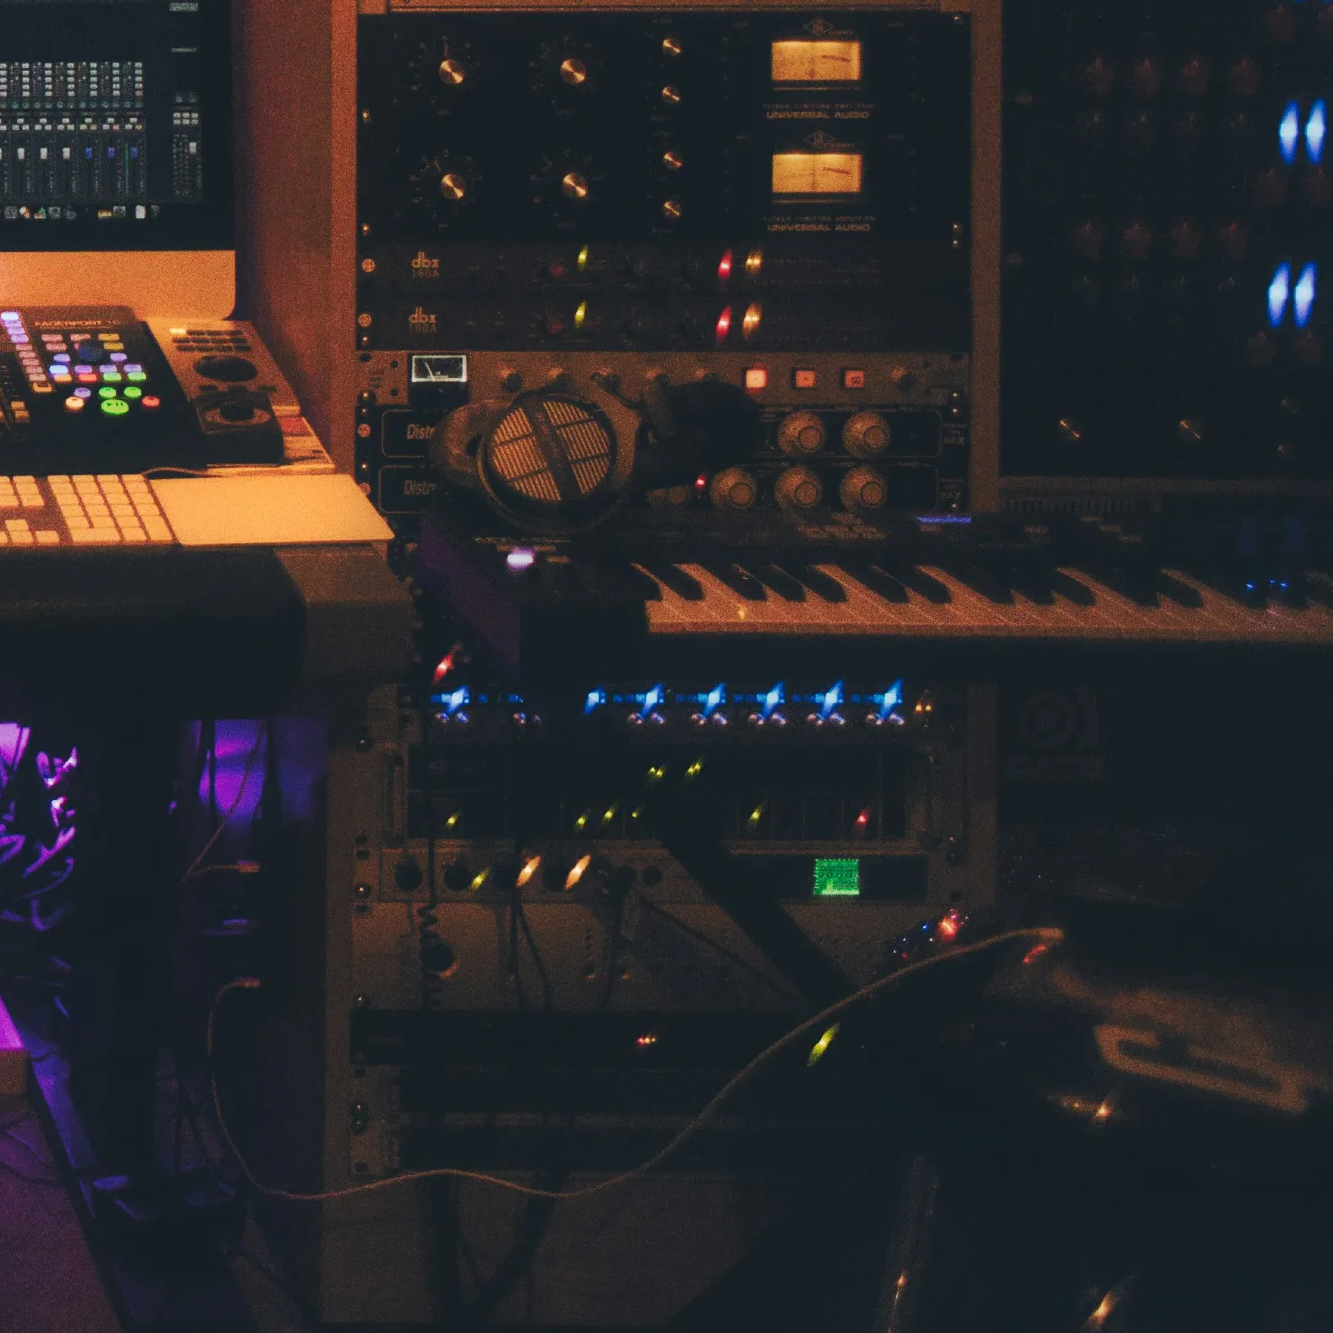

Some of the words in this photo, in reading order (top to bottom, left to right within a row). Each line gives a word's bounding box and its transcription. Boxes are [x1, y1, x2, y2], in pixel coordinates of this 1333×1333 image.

[766, 111, 830, 119] UNIVERSAL
[834, 110, 871, 119] AUDIO
[767, 223, 831, 232] UNIVERSAL
[835, 223, 871, 231] AUDIO
[410, 250, 440, 268] dbx
[408, 306, 437, 323] dbx
